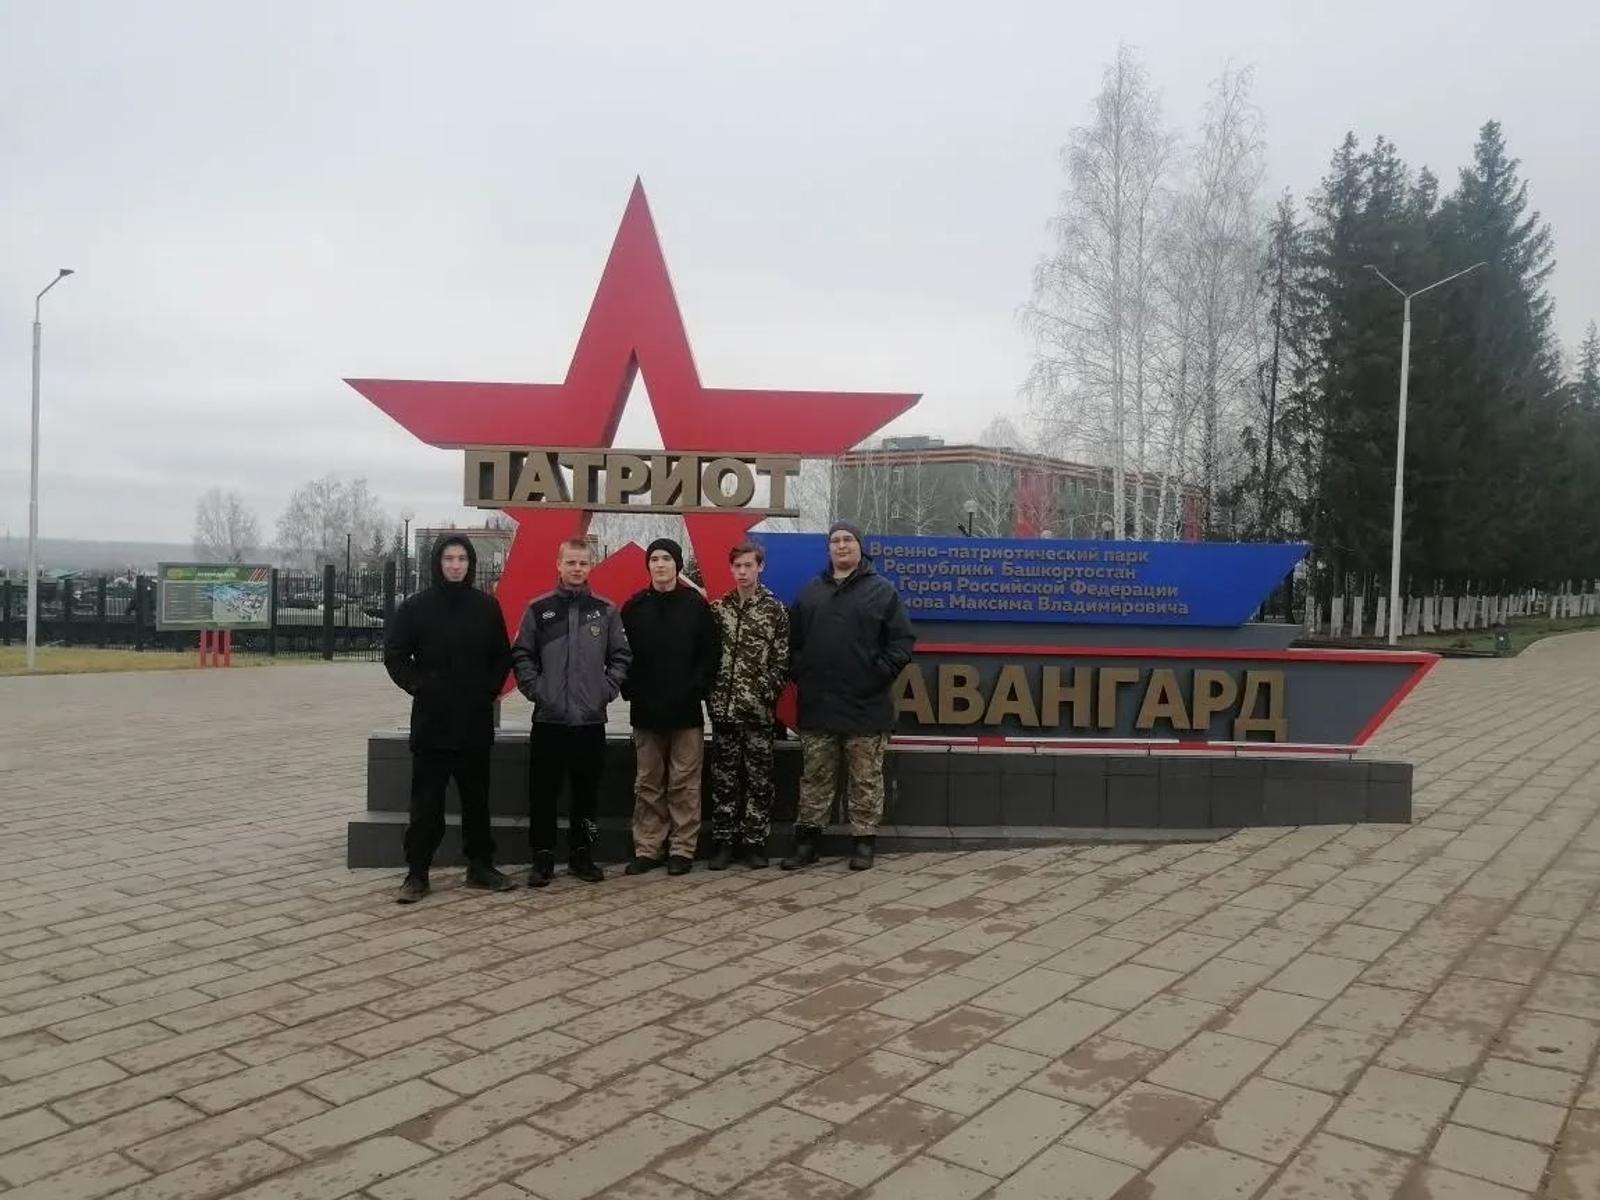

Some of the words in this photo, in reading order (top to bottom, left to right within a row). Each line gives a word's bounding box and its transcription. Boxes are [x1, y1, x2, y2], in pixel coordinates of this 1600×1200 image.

[464, 449, 801, 509] ПАТРИОТ
[870, 542, 1100, 562] Военно-патриотический
[1103, 550, 1150, 564] парк
[884, 559, 994, 578] Республики
[1001, 561, 1136, 581] Башкортостан
[899, 576, 952, 594] Героя
[957, 577, 1065, 595] Российской
[1070, 579, 1179, 599] Федерации
[949, 594, 1034, 611] Максима
[1038, 596, 1189, 617] Владимировича
[888, 662, 1288, 743] АВАНГАРД
